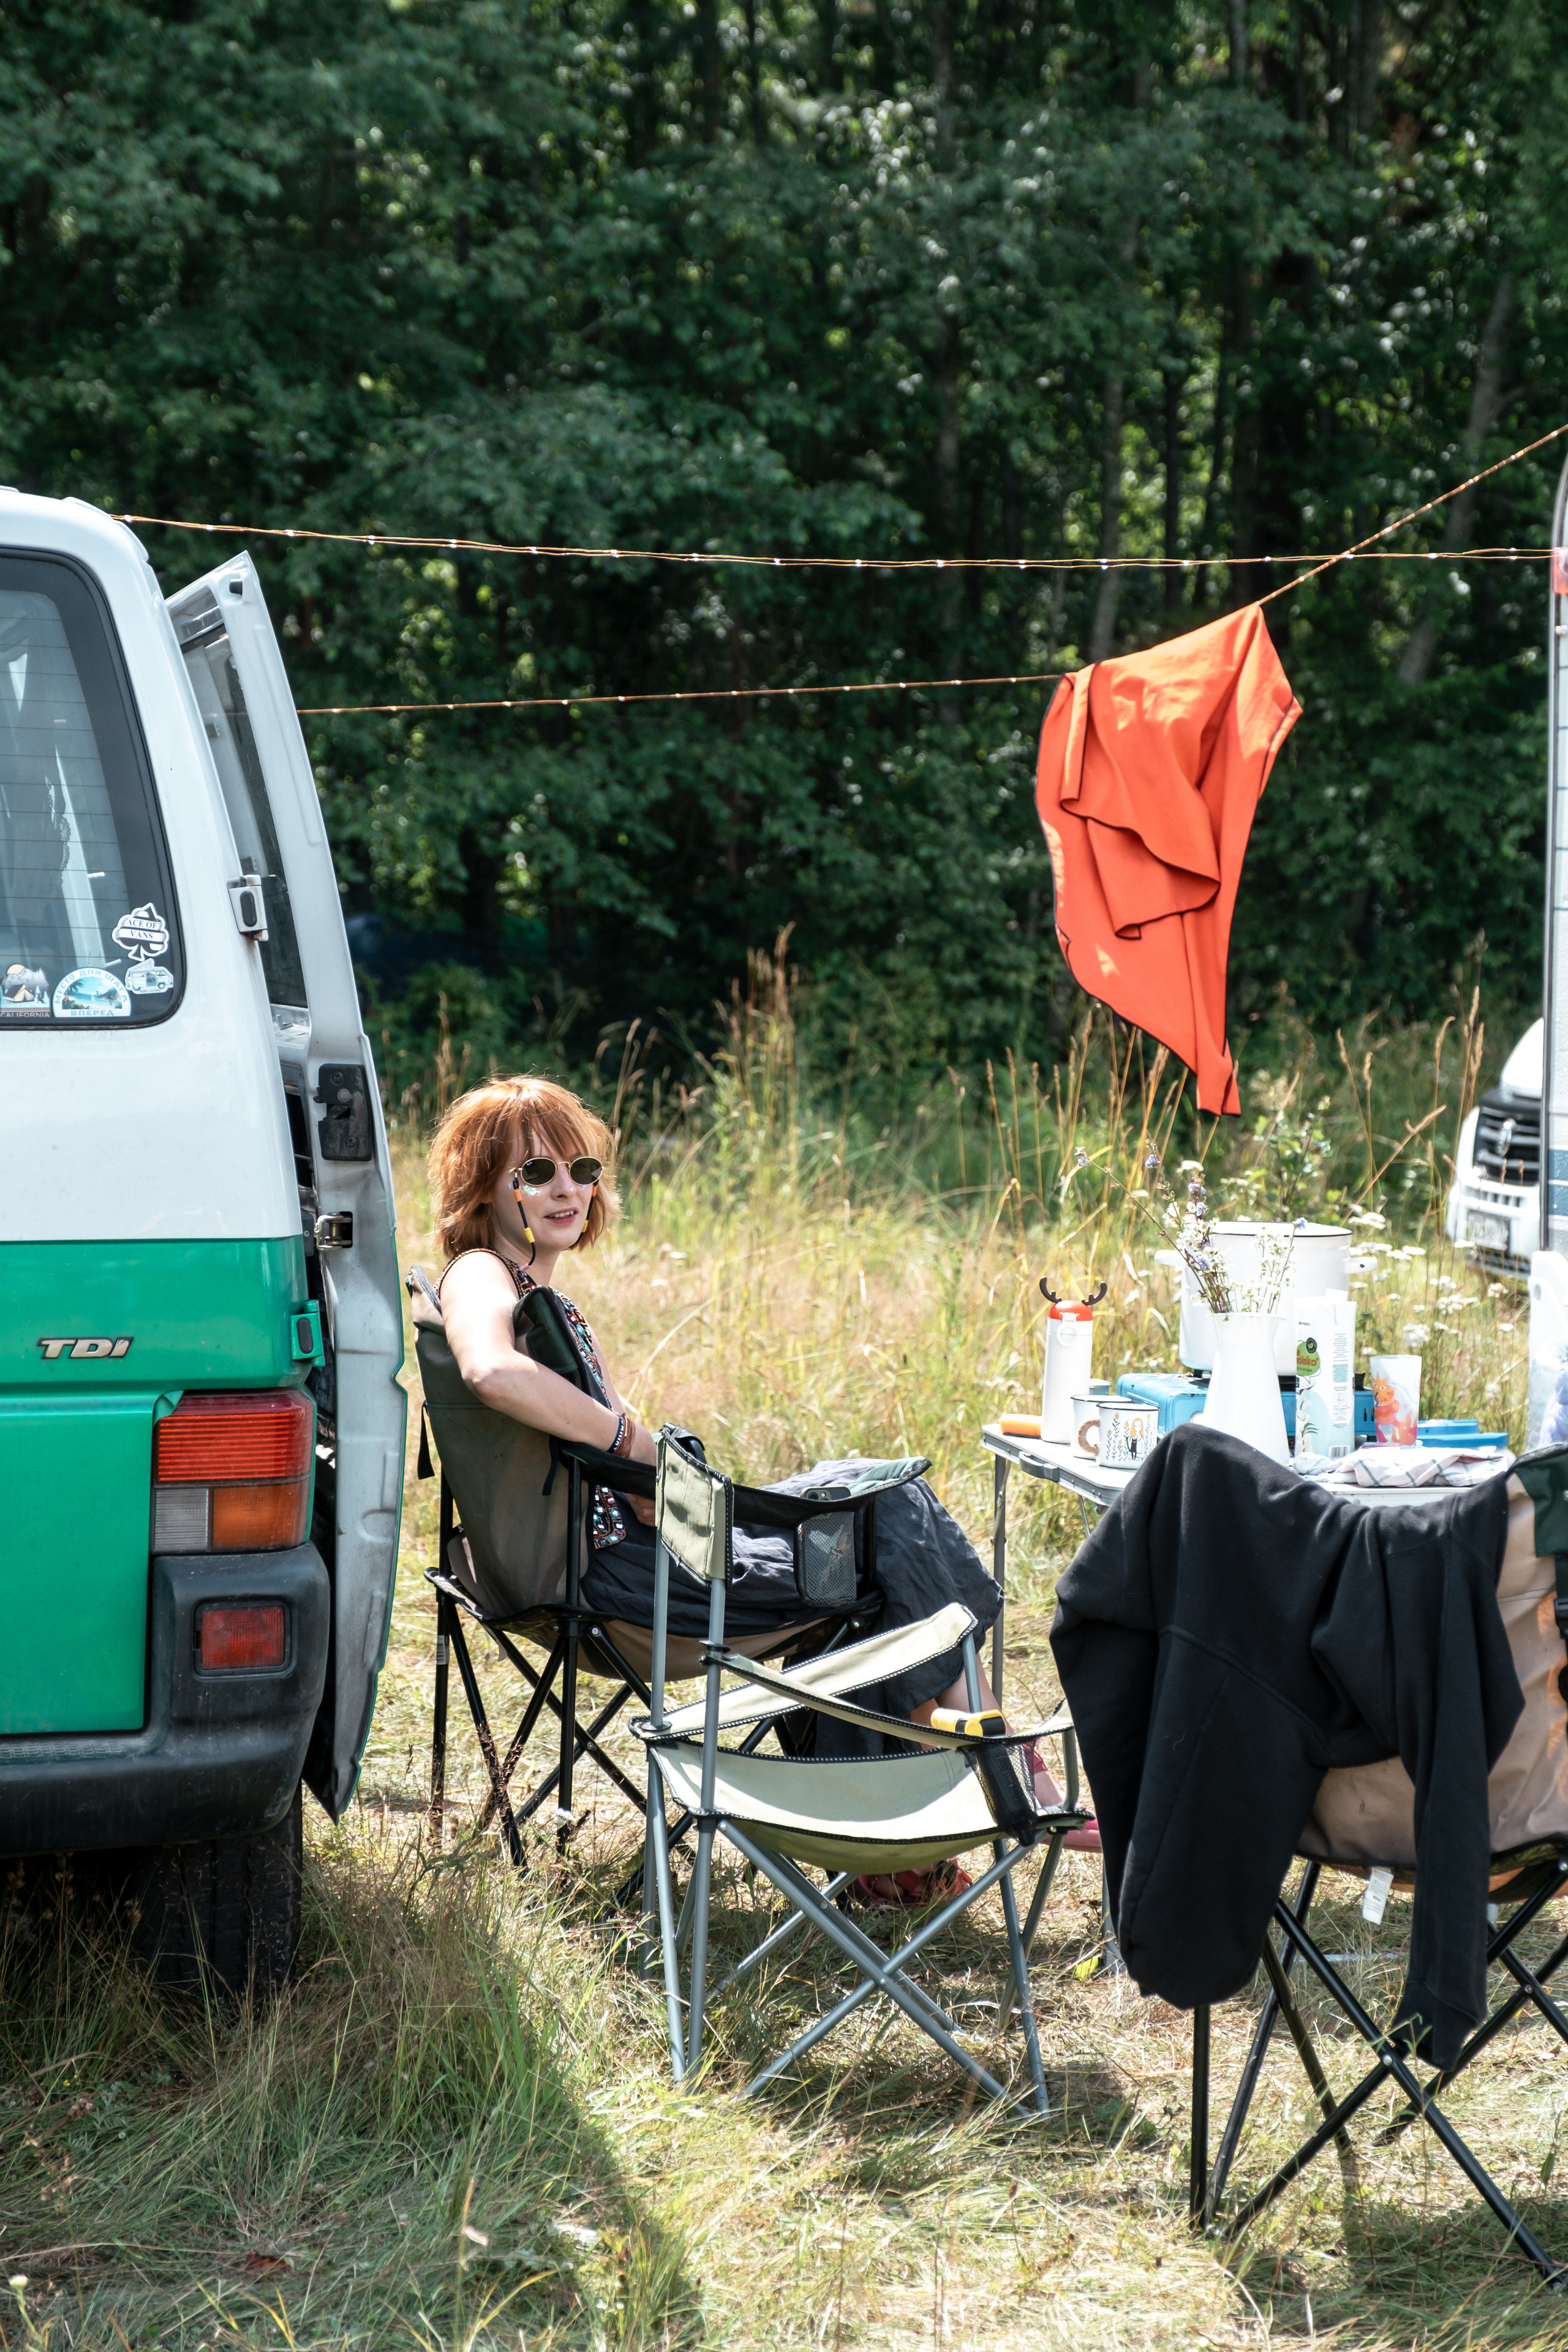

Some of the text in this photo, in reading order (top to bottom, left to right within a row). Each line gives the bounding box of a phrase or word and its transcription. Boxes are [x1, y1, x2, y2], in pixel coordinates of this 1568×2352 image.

[127, 919, 144, 927] ACE
[130, 930, 154, 940] VANS
[55, 969, 128, 1005] МЕСТО ДЛЯ ШАГА
[36, 1336, 134, 1359] TDI
